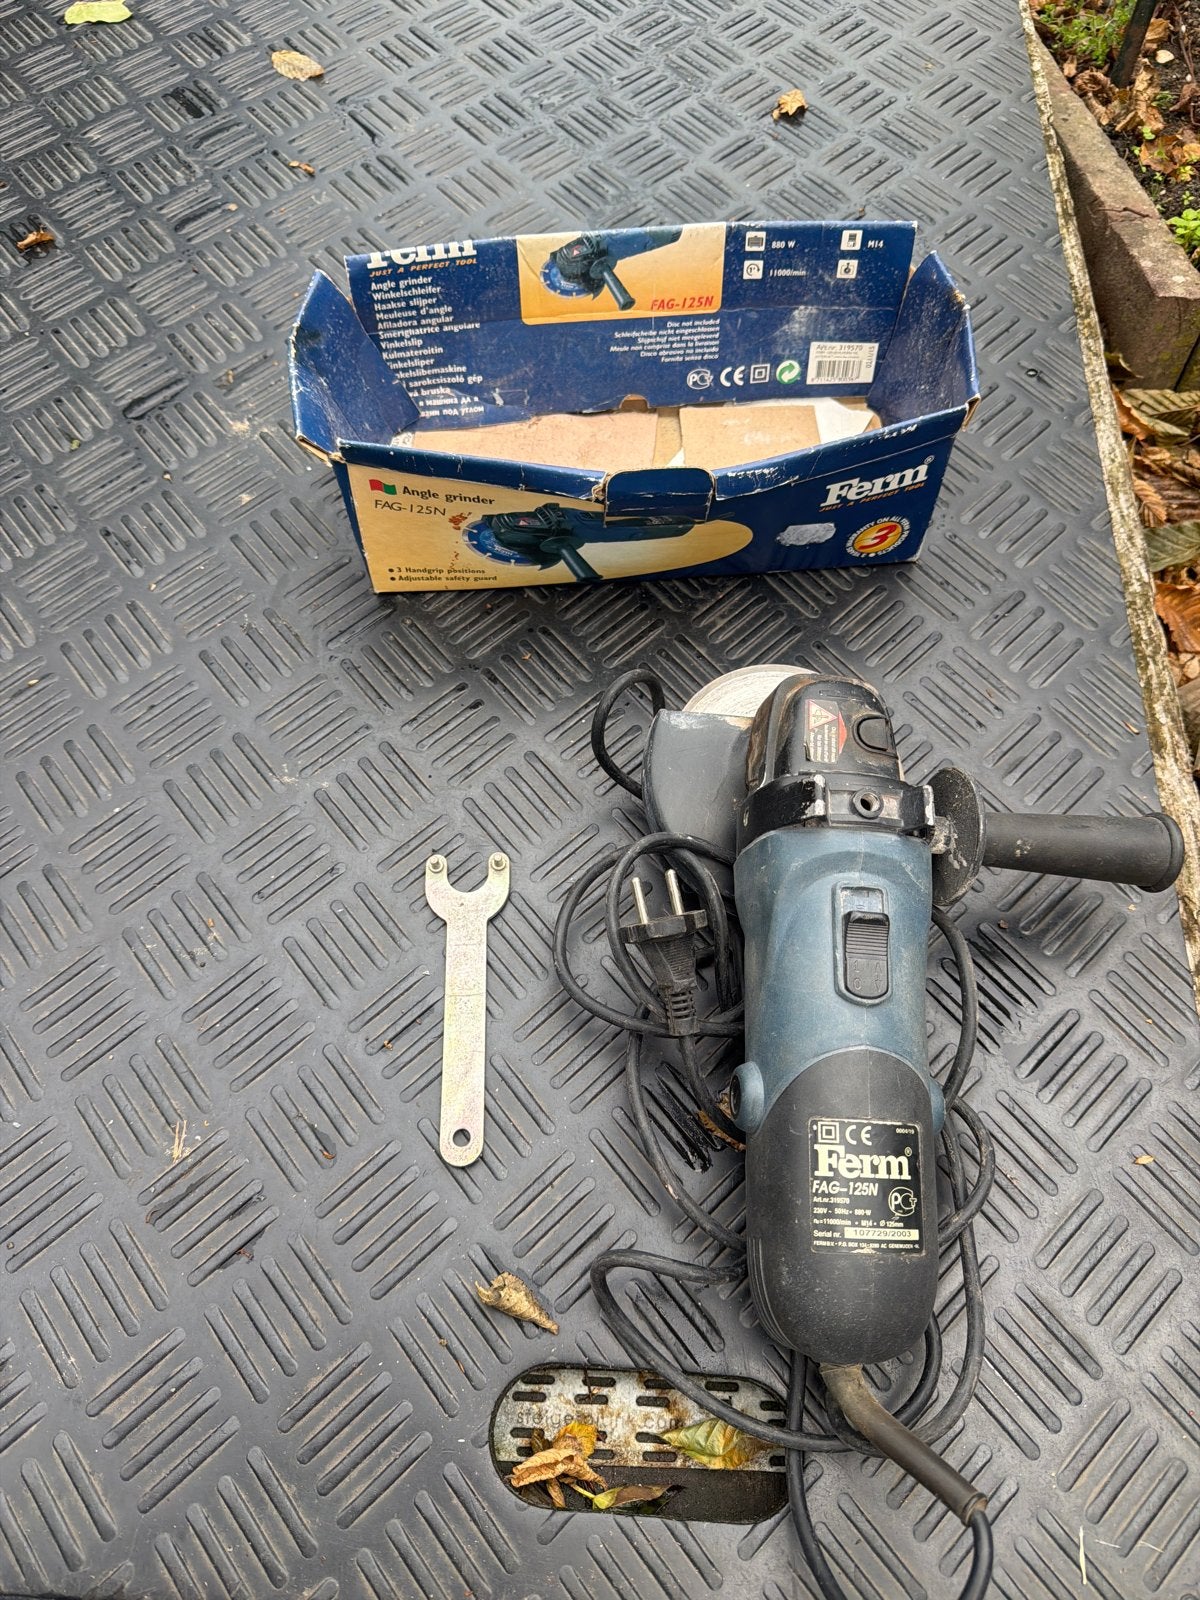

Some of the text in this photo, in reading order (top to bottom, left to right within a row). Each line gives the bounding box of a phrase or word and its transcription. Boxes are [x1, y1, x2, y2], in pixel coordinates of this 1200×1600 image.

[771, 240, 796, 249] 880 W
[867, 240, 884, 249] M14
[369, 269, 393, 277] JUST
[410, 261, 450, 271] PERFECT
[455, 258, 478, 266] TOOL
[769, 268, 806, 277] 11000/min
[371, 275, 432, 291] Angle grinder
[372, 286, 441, 301] Winkelschleifer
[374, 297, 437, 311] Haakse slijper
[650, 296, 714, 310] FAG-125N
[375, 305, 453, 321] Meuleuse d'angle
[378, 315, 454, 330] Afiladora angular
[693, 318, 720, 326] included
[380, 338, 423, 350] Vinkelslip
[839, 344, 863, 352] 319570
[387, 358, 435, 370] inkelsliper
[467, 374, 483, 385] gép
[421, 386, 451, 396] bruska
[402, 486, 495, 505] Angle grinder
[374, 499, 446, 516] FAG-125N
[890, 515, 902, 523] ALL
[857, 524, 898, 550] 3
[405, 567, 444, 575] Handgrip
[812, 1181, 879, 1196] FAG-125N
[813, 1229, 833, 1238] Serial
[854, 1229, 912, 1238] 107729/2003
